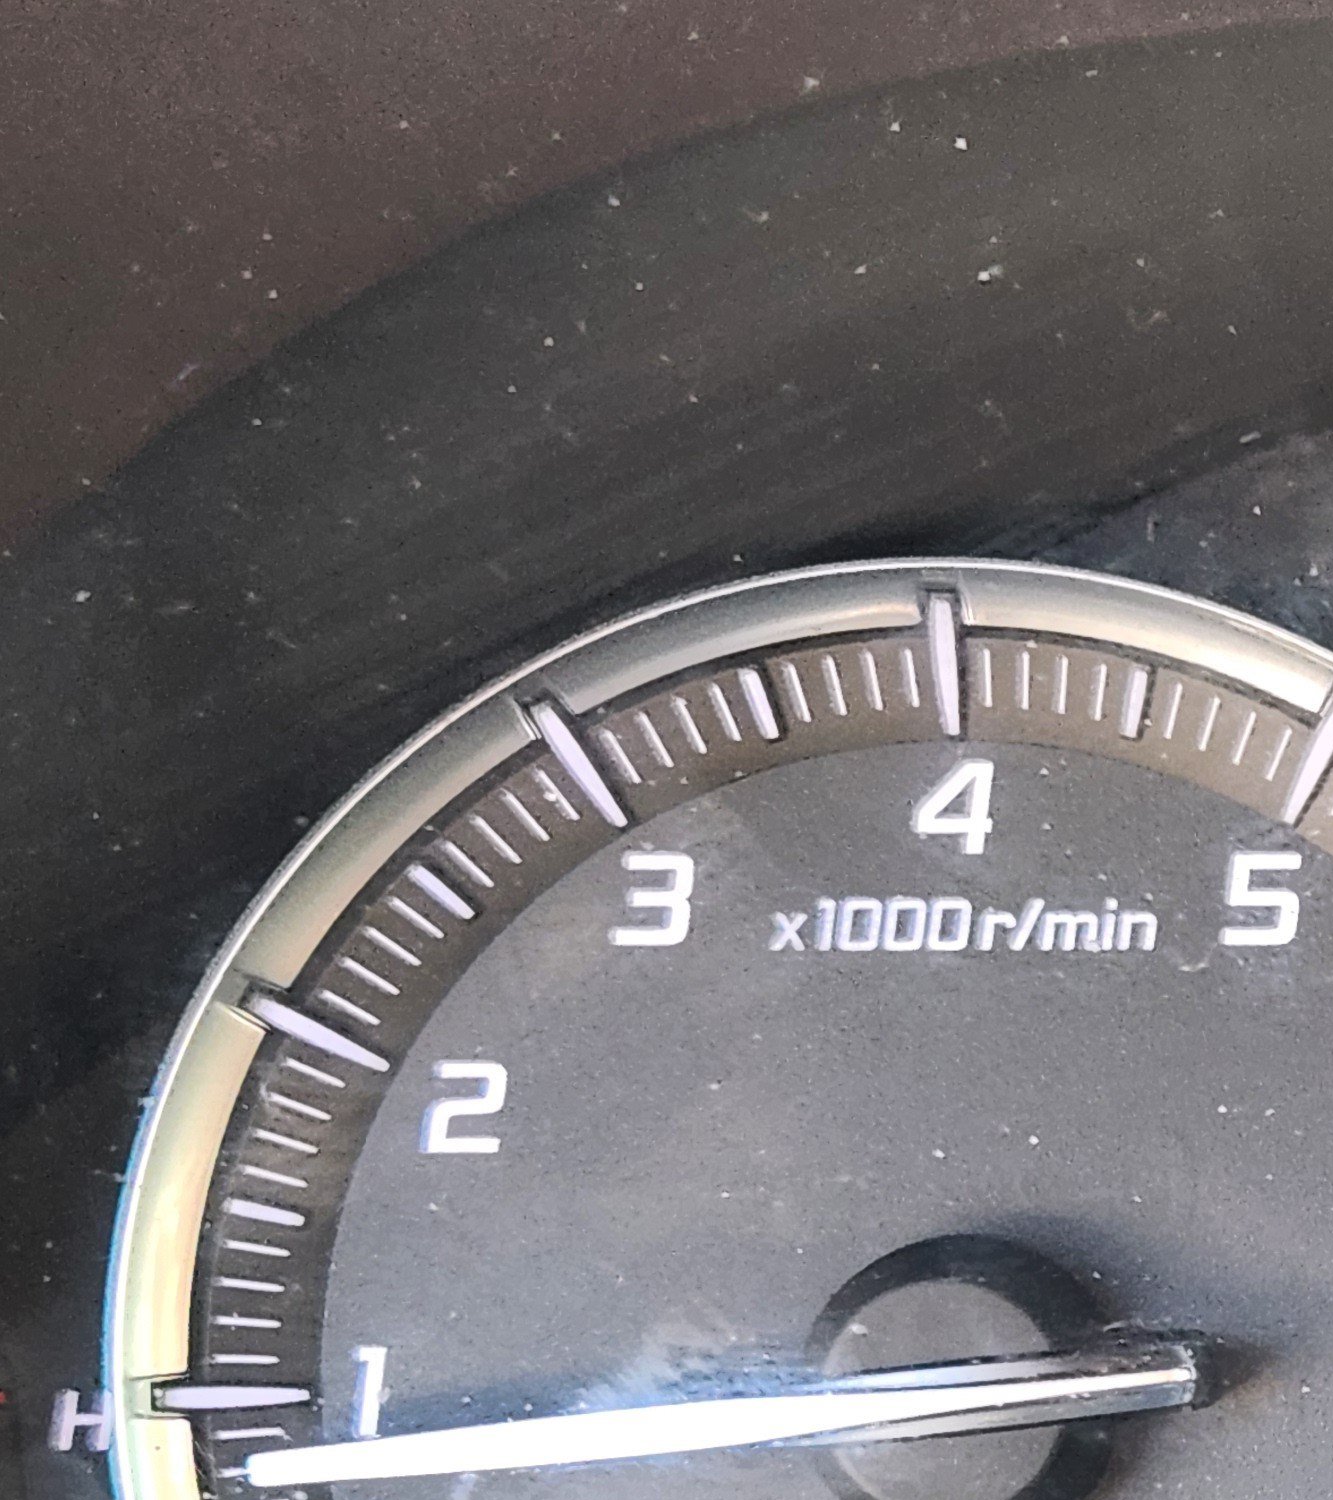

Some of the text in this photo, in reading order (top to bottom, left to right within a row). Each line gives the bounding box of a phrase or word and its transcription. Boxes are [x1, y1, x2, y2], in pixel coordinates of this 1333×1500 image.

[911, 759, 994, 854] 4
[608, 851, 694, 946] 3
[1220, 851, 1302, 946] 5
[424, 1061, 507, 1153] 2
[48, 1388, 112, 1451] H
[352, 1346, 387, 1437] 1
